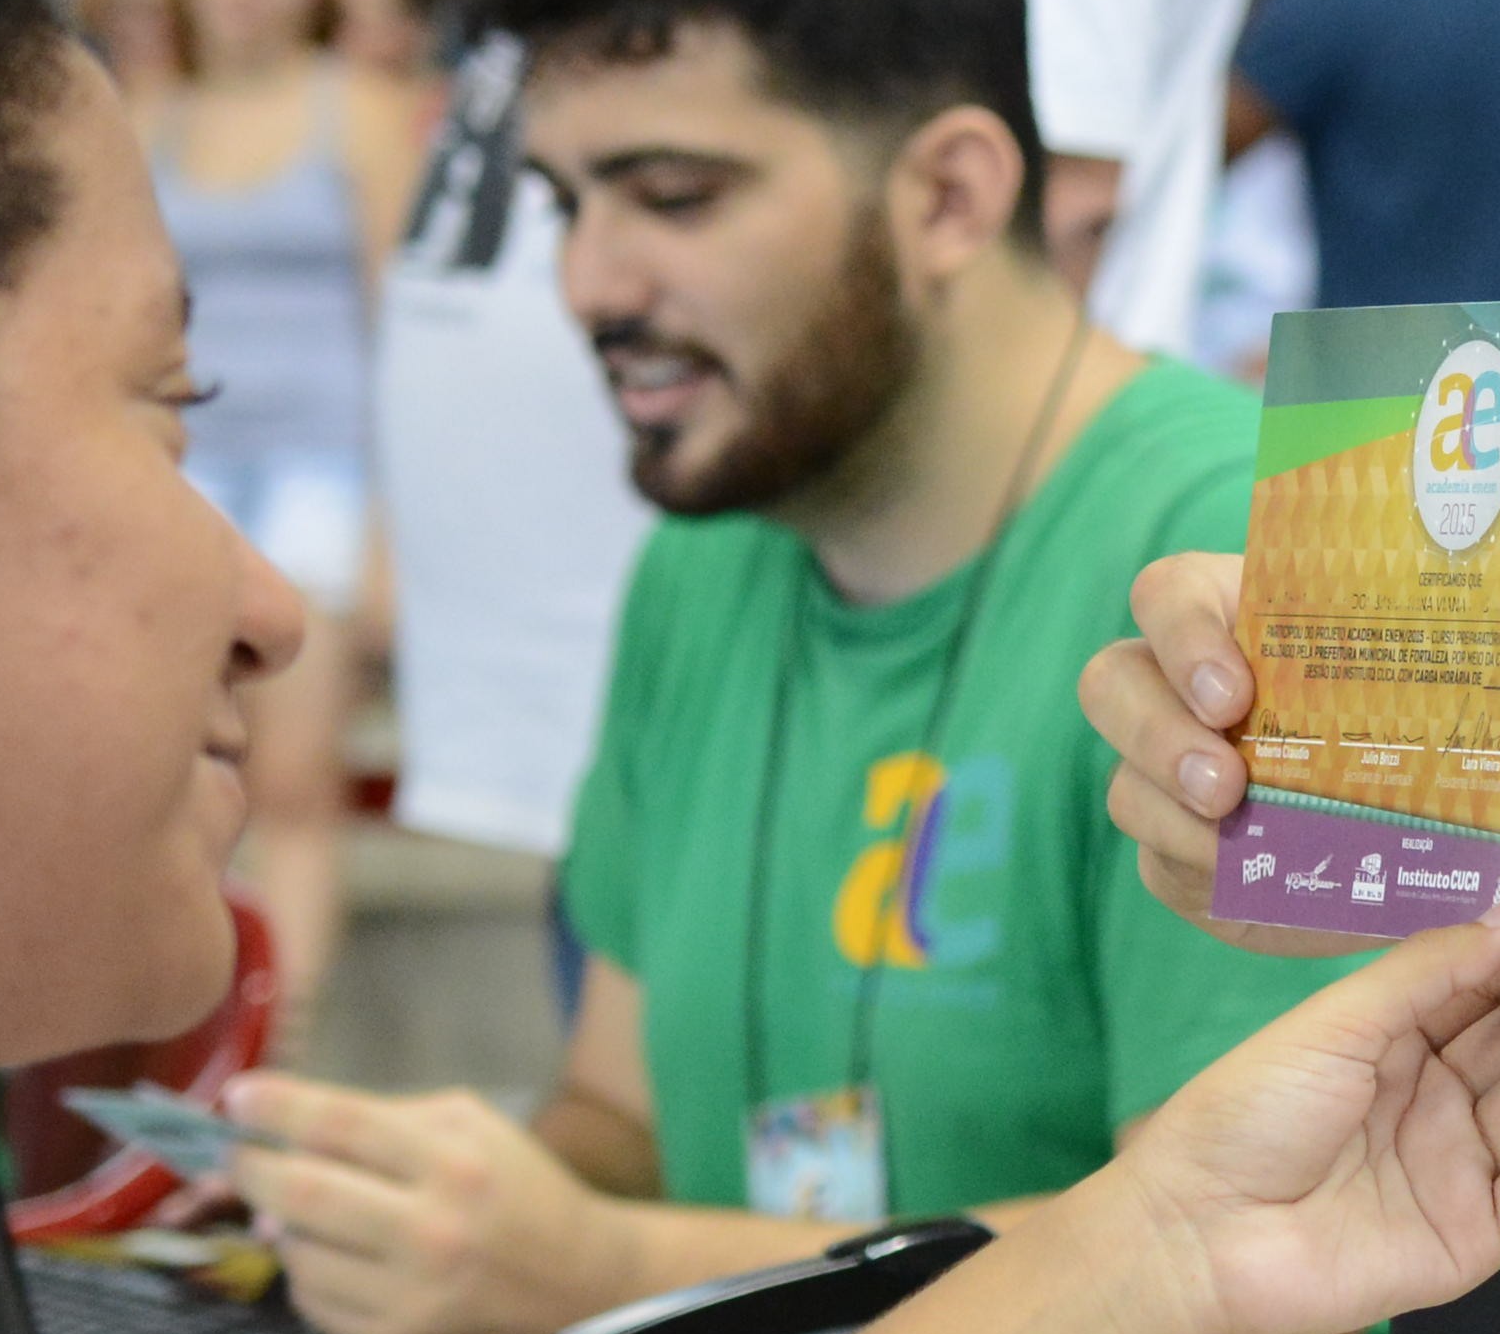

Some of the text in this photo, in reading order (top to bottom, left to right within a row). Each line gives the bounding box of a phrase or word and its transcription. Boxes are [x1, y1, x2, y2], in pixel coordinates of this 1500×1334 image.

[1425, 477, 1498, 495] academia enem
[1439, 503, 1477, 536] 2015
[1418, 572, 1483, 589] CERTIFICAMOS QUE
[1315, 625, 1346, 641] PROJETO
[1347, 627, 1383, 642] ACADEMIA
[1431, 630, 1455, 645] CURSO
[1297, 644, 1313, 658] PELA
[1315, 646, 1357, 660] PREFEITURA
[1358, 647, 1396, 662] MUNICIPAL
[1398, 648, 1408, 663] DE
[1451, 650, 1466, 664] POR
[1467, 651, 1484, 665] MEIO
[1331, 665, 1342, 680] DO
[1344, 666, 1375, 681] INSTITUTO
[1398, 668, 1413, 683] COM
[1415, 669, 1438, 684] CARGA
[1439, 671, 1470, 685] HORÁRIA
[1471, 671, 1482, 685] DE
[1461, 756, 1500, 772] Lara Vieira
